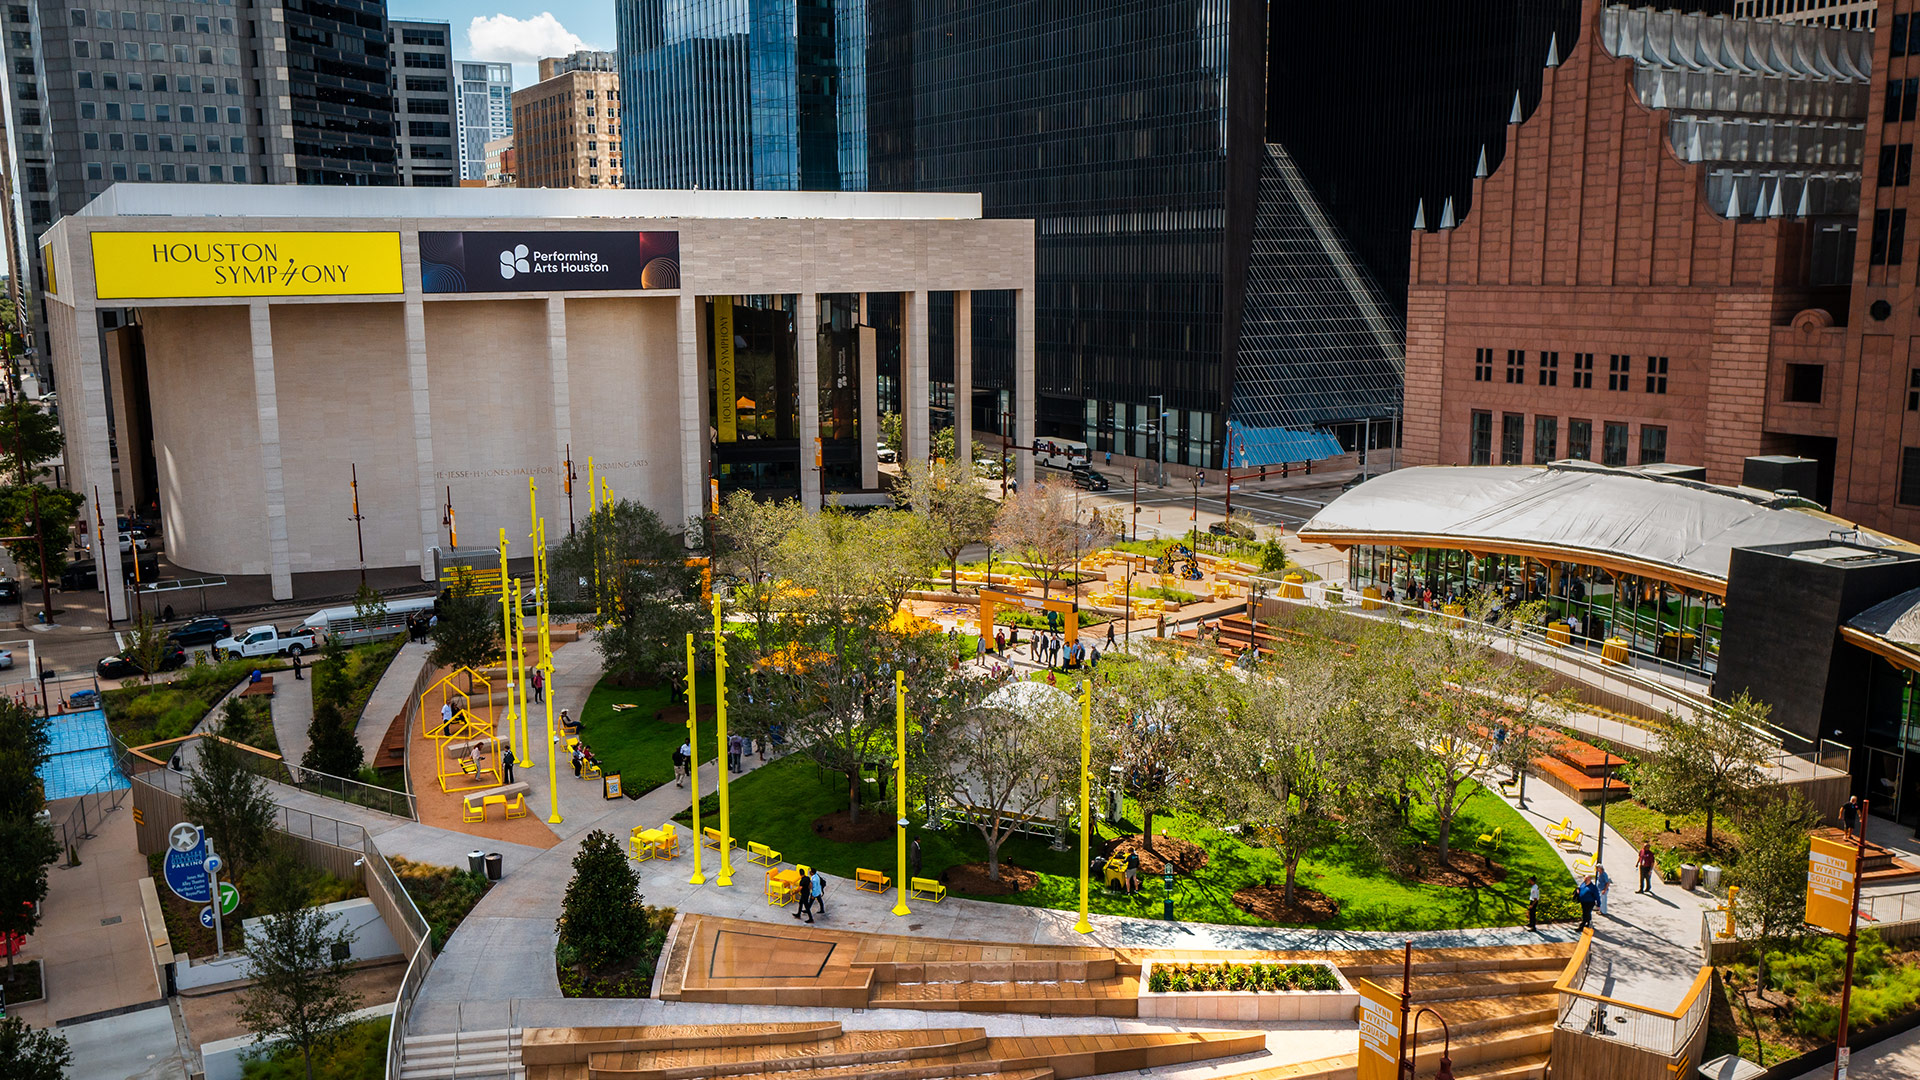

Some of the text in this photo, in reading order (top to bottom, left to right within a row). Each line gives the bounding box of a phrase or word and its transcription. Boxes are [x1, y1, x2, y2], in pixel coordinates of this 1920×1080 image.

[152, 243, 278, 263] HOUSTON
[533, 250, 598, 263] Performing
[214, 258, 350, 287] SYMPHONY
[533, 262, 609, 273] Arts Houston
[719, 315, 732, 423] HOUSTON SYMPHONY
[171, 860, 204, 869] PARKING
[209, 860, 218, 871] P
[1826, 856, 1846, 869] LYNN
[1815, 864, 1841, 877] WYATT
[1810, 873, 1841, 888] SQUARE
[222, 890, 235, 906] 7
[1374, 1003, 1392, 1020] LYNN
[1365, 1011, 1388, 1031] WYATT
[1360, 1022, 1388, 1044] SQUARE
